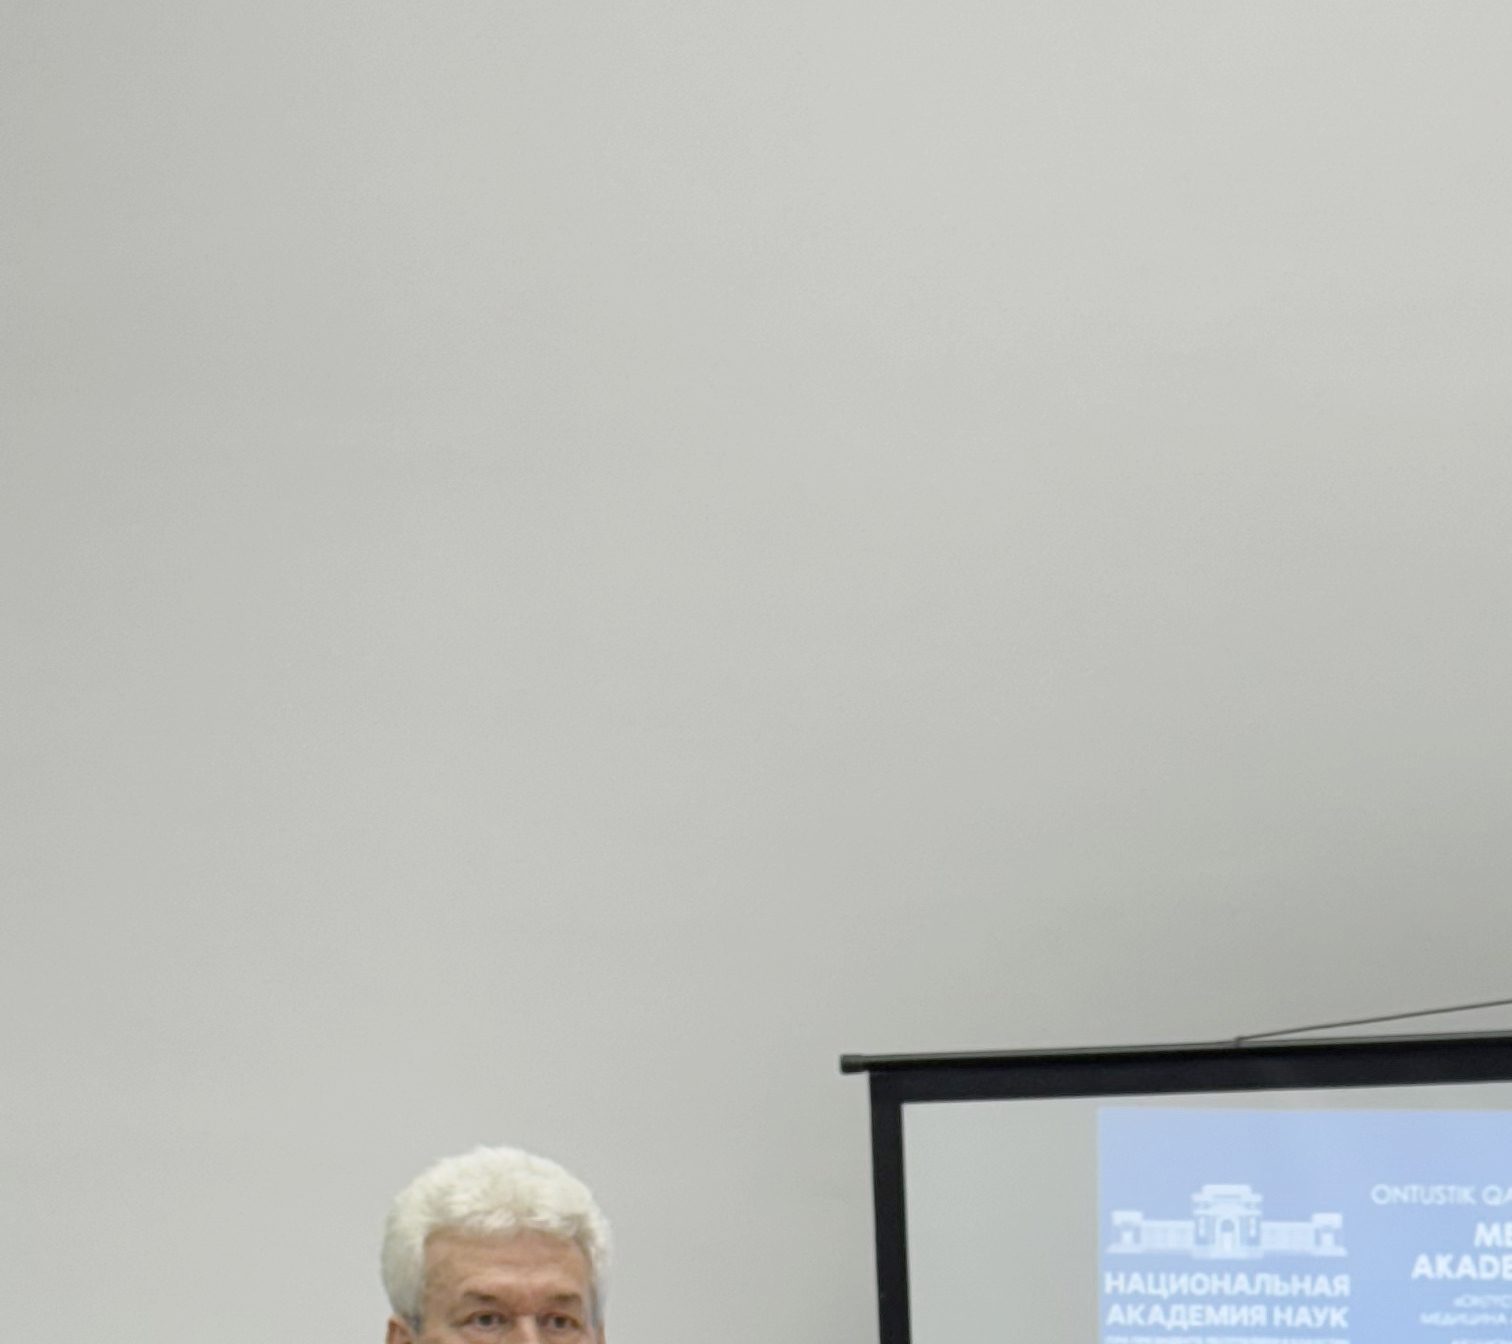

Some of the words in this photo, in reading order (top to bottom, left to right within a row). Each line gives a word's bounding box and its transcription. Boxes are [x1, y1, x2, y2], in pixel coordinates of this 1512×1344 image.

[1104, 1272, 1351, 1299] НАЦИОНАЛЬНАЯ
[1106, 1304, 1267, 1330] АКАДЕМИЯ
[1274, 1306, 1349, 1328] НАУК
